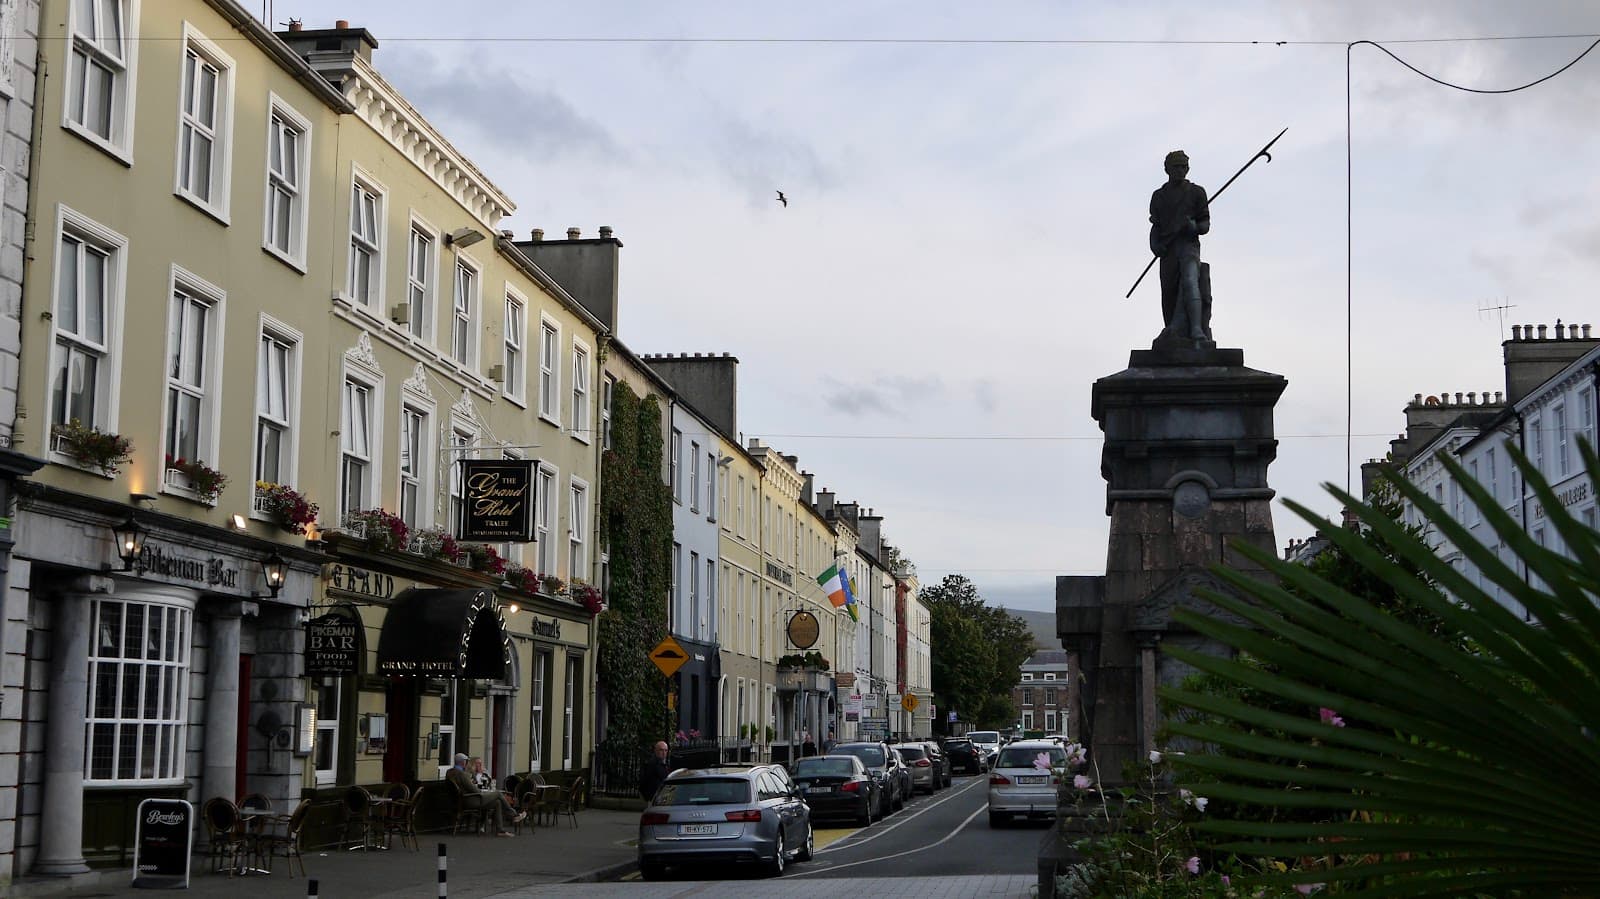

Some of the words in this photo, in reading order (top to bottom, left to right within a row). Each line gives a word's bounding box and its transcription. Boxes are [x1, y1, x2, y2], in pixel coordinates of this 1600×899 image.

[468, 473, 529, 499] Grand
[502, 477, 516, 485] THE
[473, 499, 521, 517] Hotel
[136, 543, 204, 582] Pikeman
[207, 555, 238, 588] Bar
[333, 564, 394, 599] GRAND
[323, 617, 340, 626] The
[311, 626, 356, 637] PIKEMAN
[310, 636, 355, 649] BAR
[381, 661, 416, 671] GRAND
[421, 661, 455, 671] HOTEL
[146, 809, 184, 825] Bewley's
